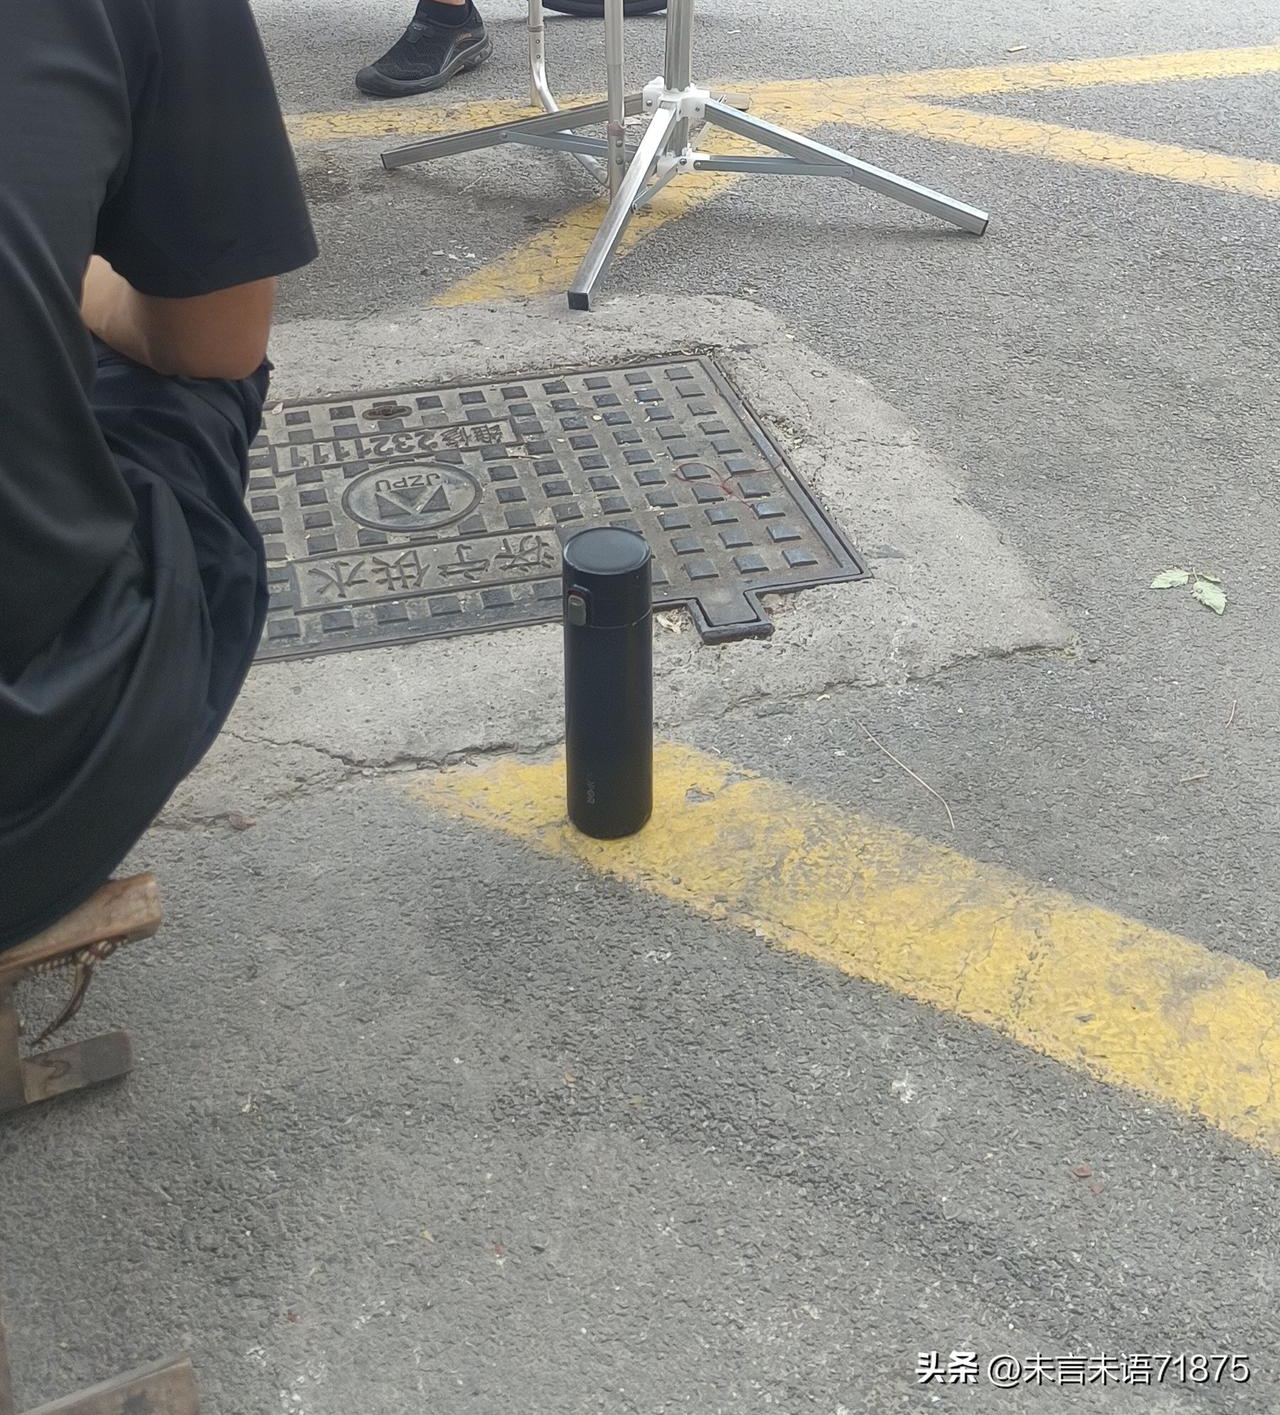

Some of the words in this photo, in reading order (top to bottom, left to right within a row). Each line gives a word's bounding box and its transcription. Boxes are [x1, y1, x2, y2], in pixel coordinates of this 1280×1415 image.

[375, 473, 441, 493] JZPU
[307, 535, 555, 599] 济宁供水
